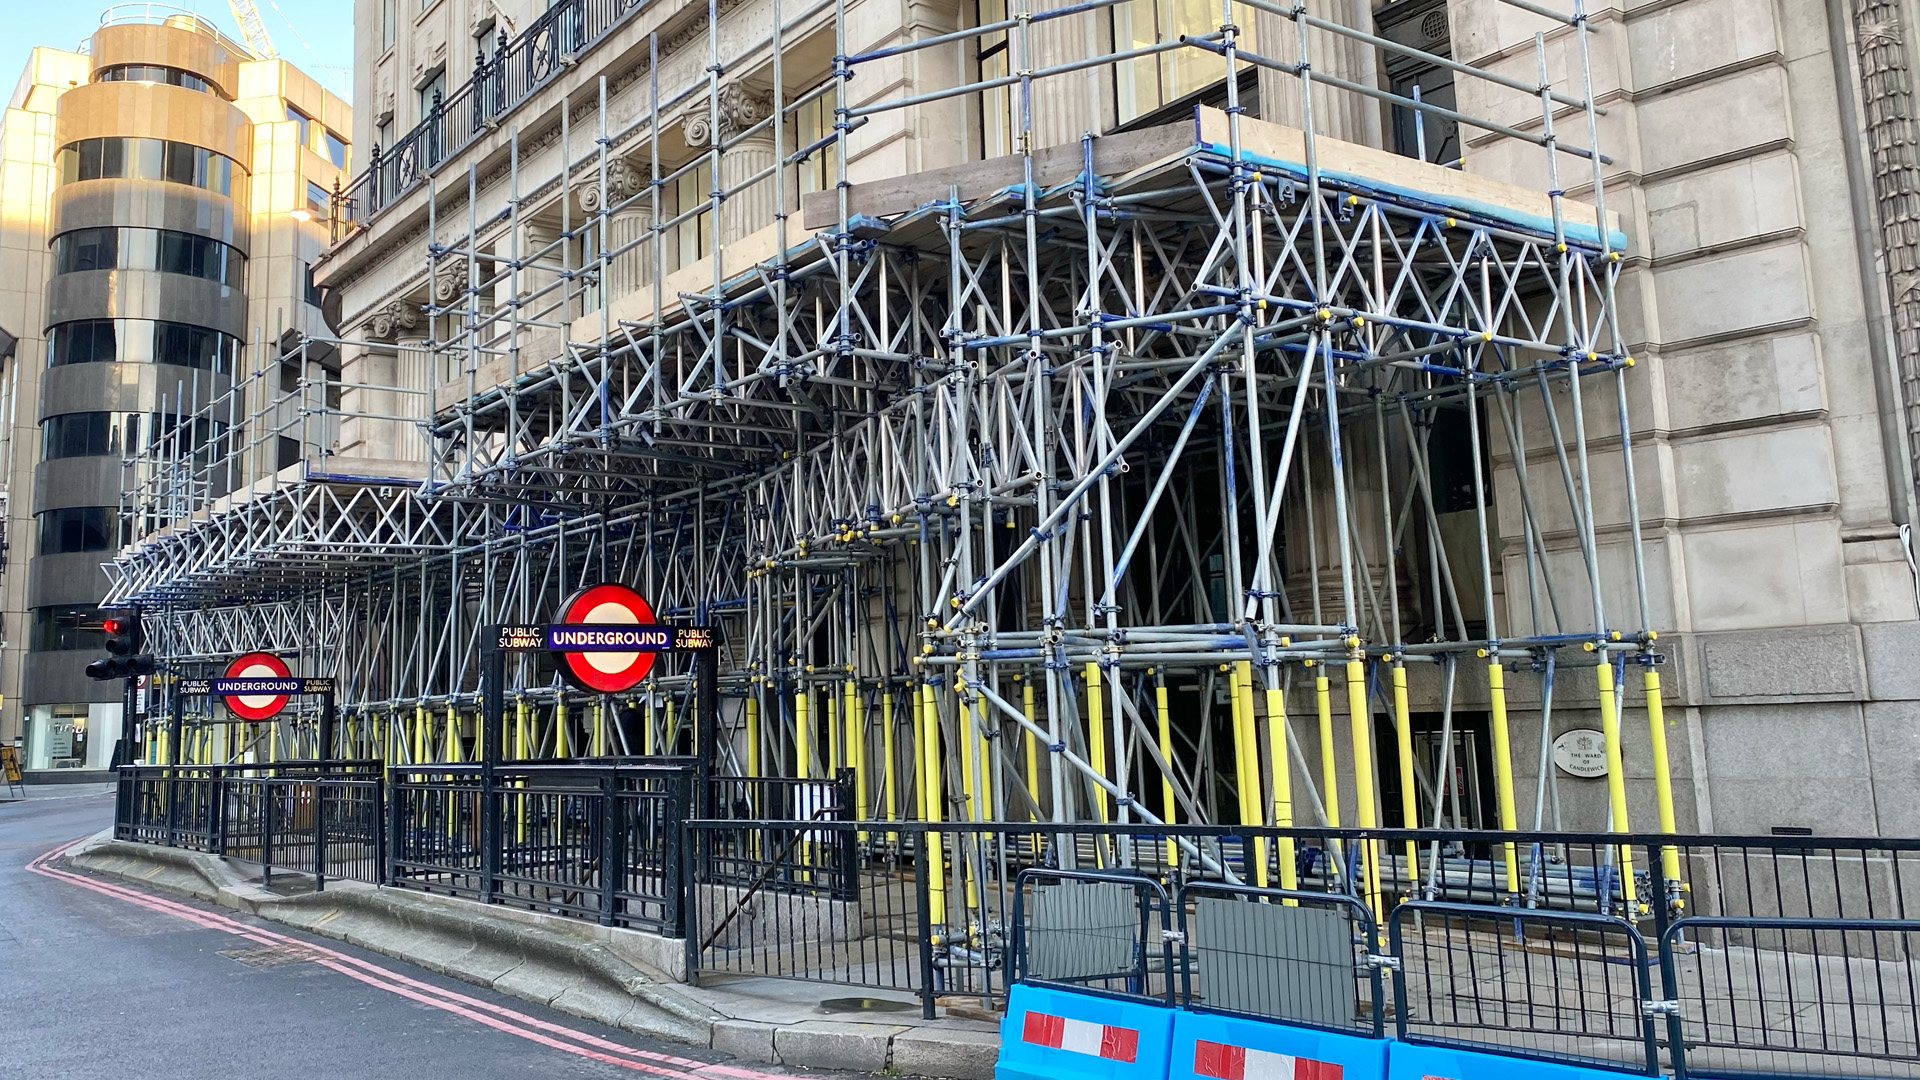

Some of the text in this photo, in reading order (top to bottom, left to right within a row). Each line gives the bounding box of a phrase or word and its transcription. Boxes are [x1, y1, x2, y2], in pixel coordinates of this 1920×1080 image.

[502, 627, 540, 637] PUBLIC
[678, 629, 711, 638] PUBLIC
[498, 637, 543, 648] SUBWAY
[553, 631, 667, 645] UNDERGROUND
[675, 638, 714, 648] SUBWAY
[180, 686, 210, 694] SUBWAY
[217, 681, 298, 691] UNDERGROUND
[1569, 764, 1604, 772] CANDLEWICK
